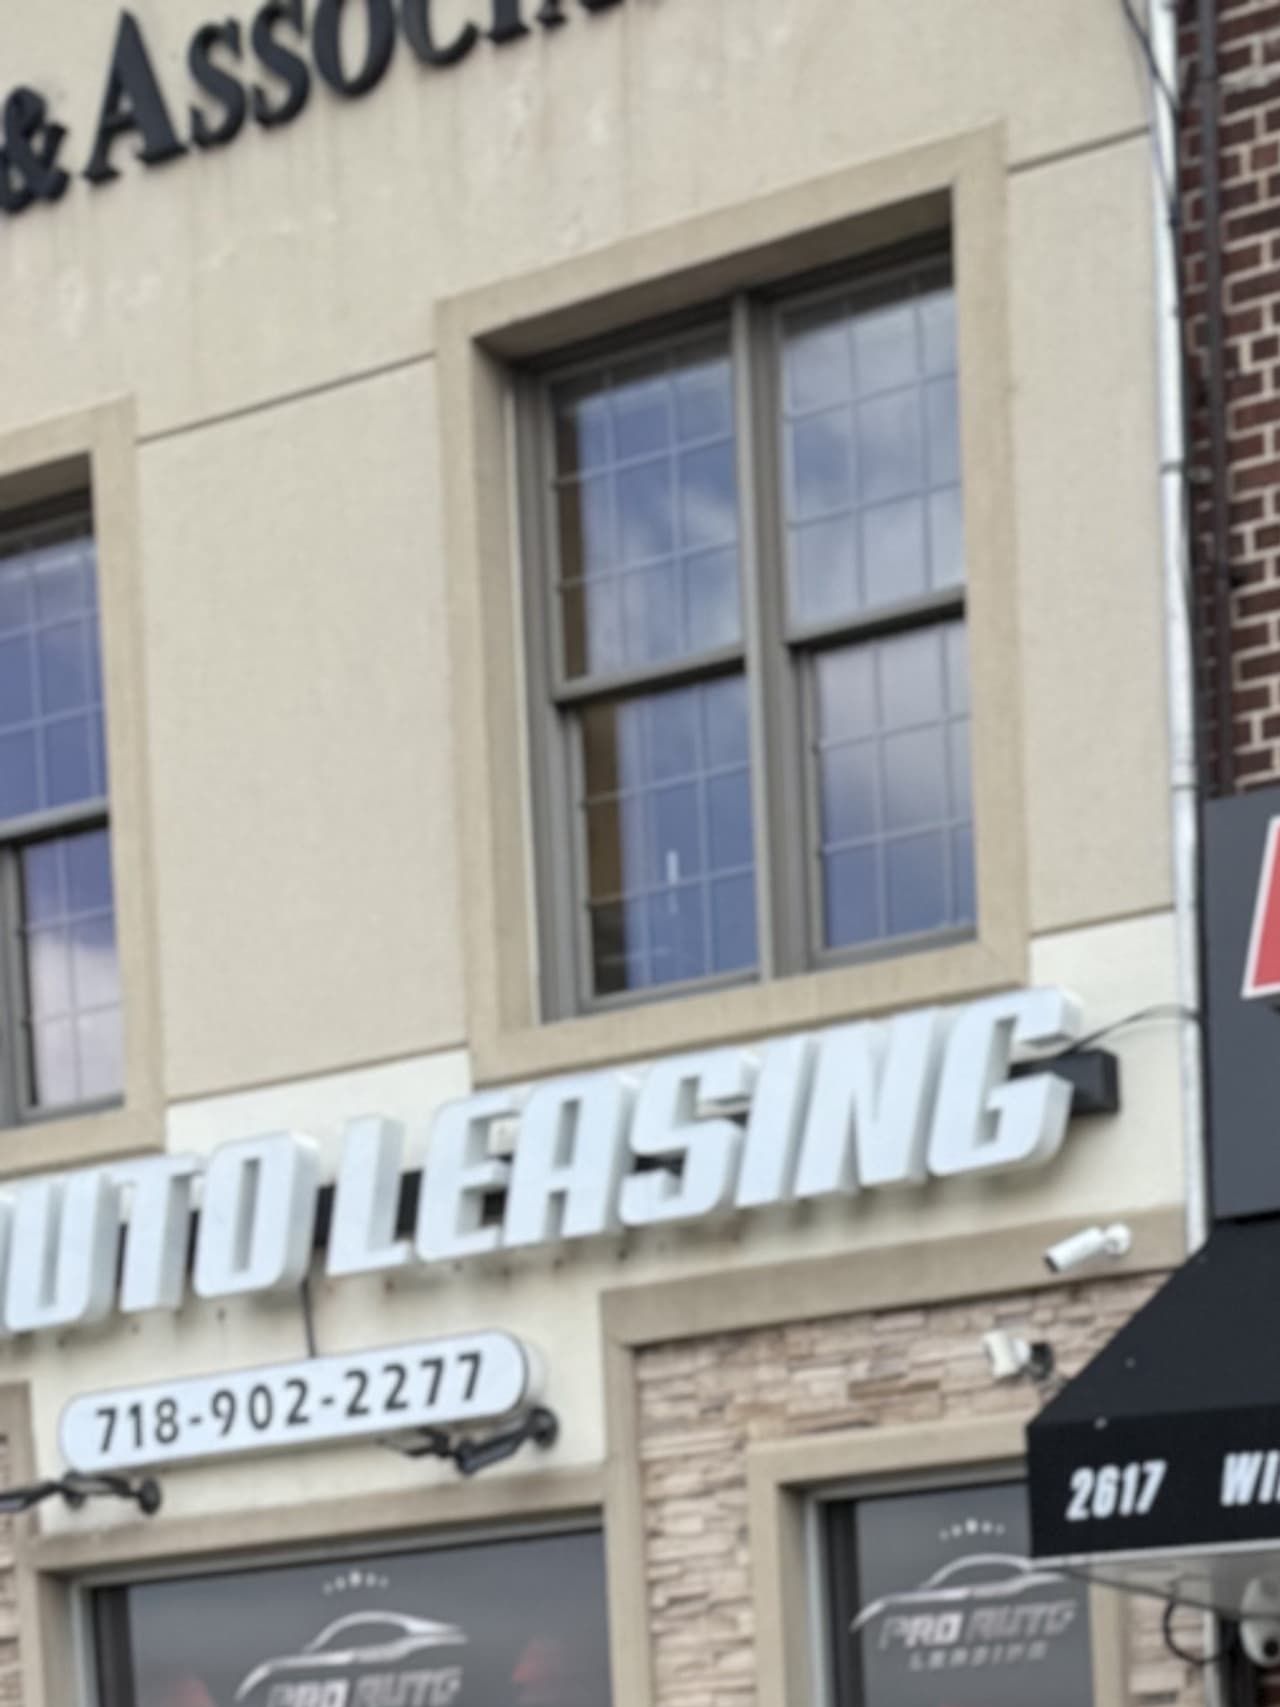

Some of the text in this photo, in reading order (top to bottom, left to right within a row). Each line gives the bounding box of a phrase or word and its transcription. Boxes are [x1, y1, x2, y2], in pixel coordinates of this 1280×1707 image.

[0, 986, 1083, 1332] UTO LEASING
[96, 1350, 486, 1456] 718-902-2277
[1066, 1459, 1167, 1522] 2617
[879, 1610, 962, 1651] PRO
